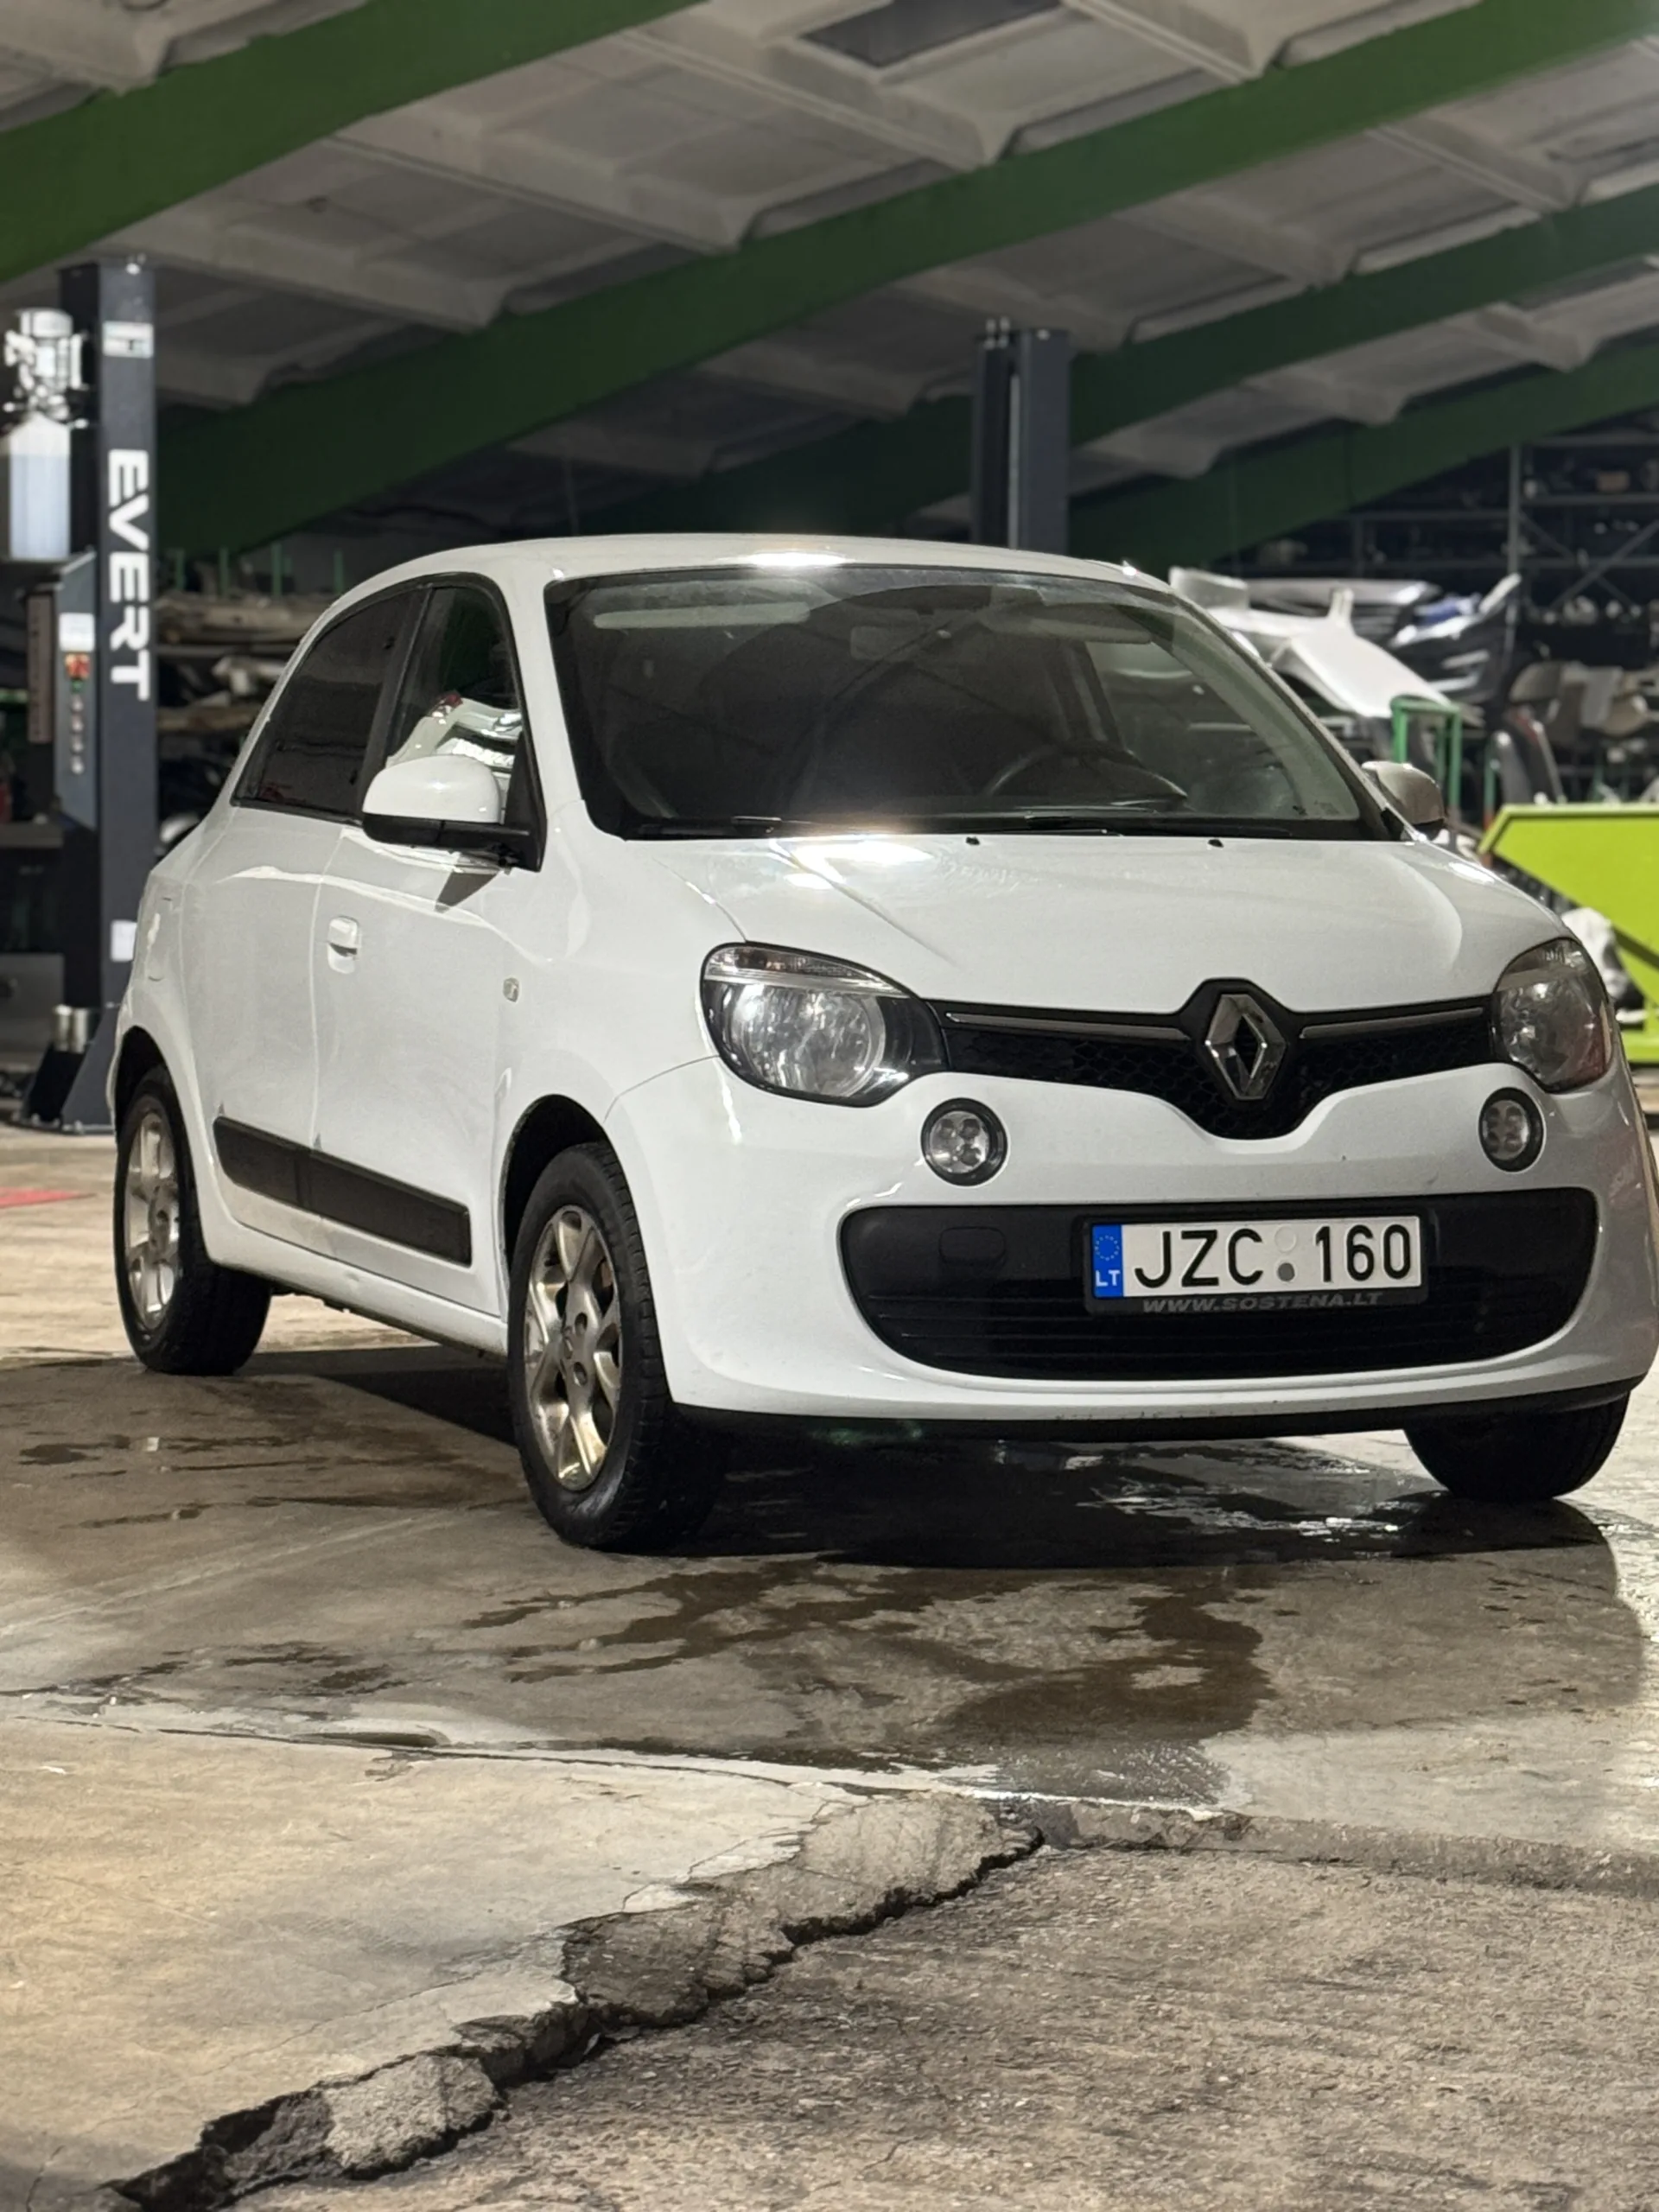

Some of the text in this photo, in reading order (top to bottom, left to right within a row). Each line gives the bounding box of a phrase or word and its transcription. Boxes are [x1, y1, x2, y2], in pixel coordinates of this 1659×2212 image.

[108, 448, 150, 701] EVERT
[1135, 1224, 1411, 1288] JZC 160
[1095, 1269, 1121, 1287] LT
[1142, 1293, 1382, 1313] WWW.SOSTENA.LT
